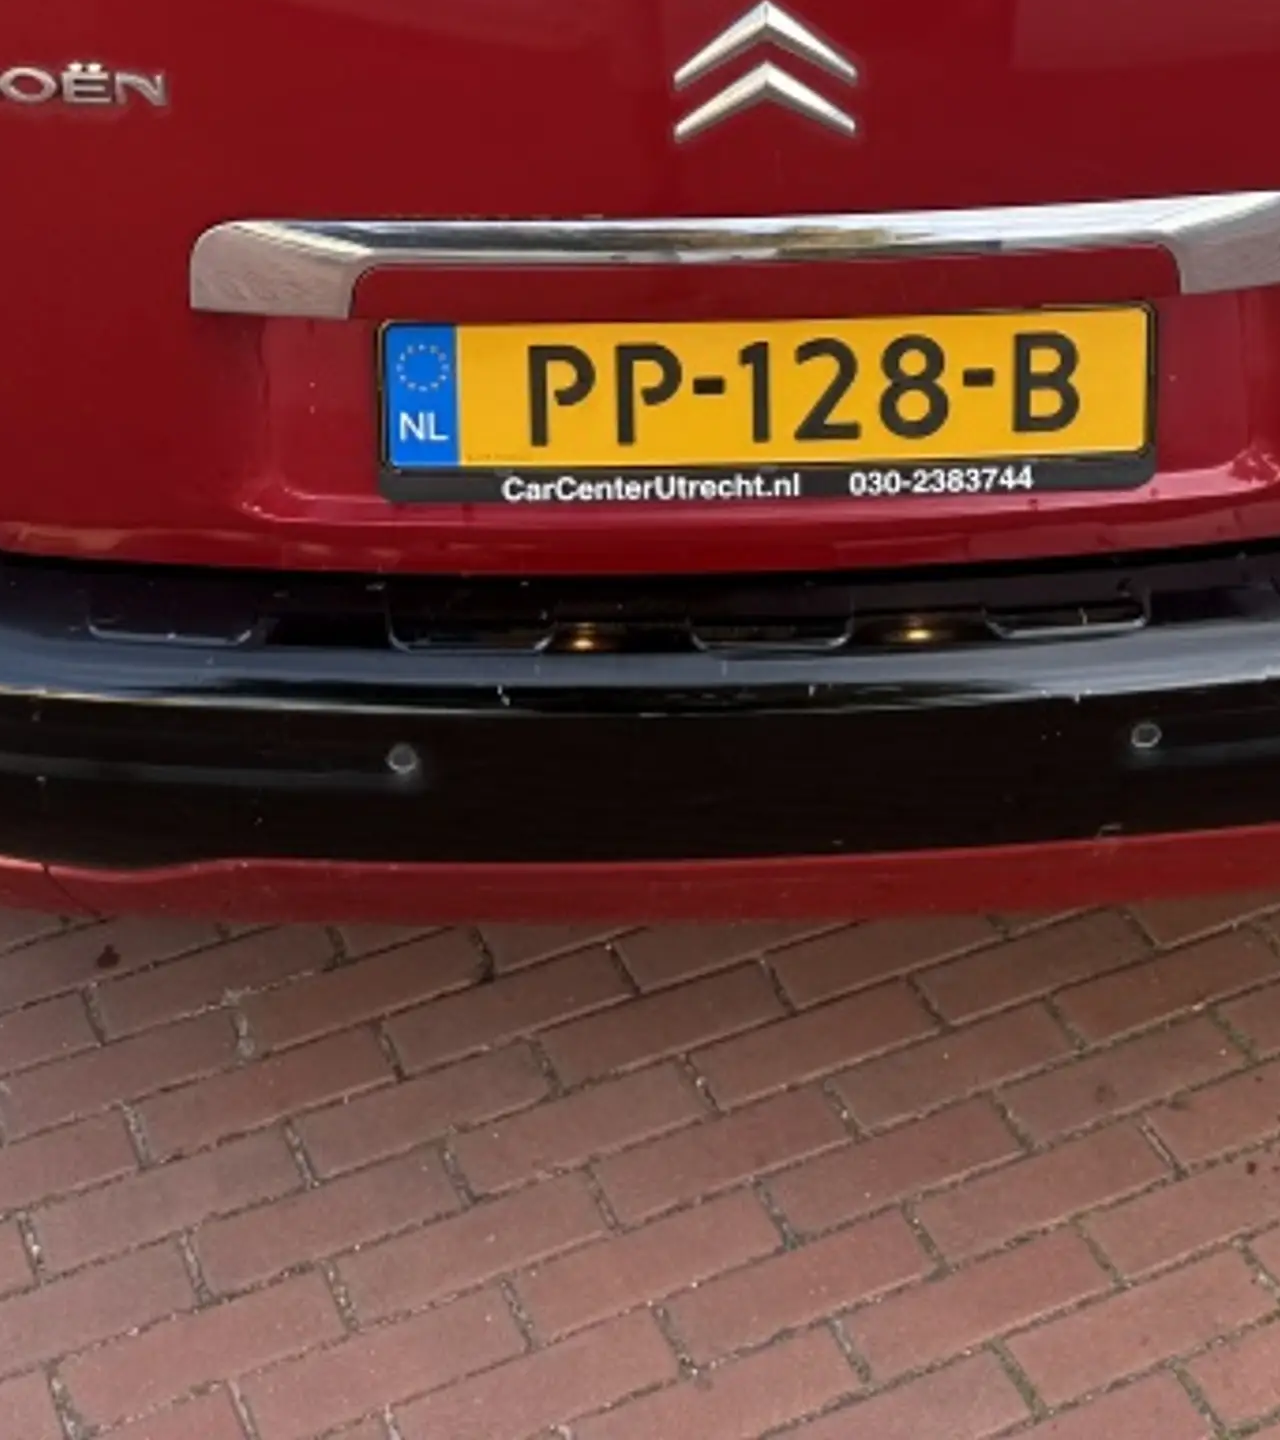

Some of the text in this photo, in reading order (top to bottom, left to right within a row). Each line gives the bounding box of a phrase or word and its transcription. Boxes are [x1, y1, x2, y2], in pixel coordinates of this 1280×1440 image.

[527, 330, 1082, 448] PP-128-B
[398, 412, 449, 442] NL
[502, 463, 1034, 502] CarCenterUtrecht.nl 030-2383744
